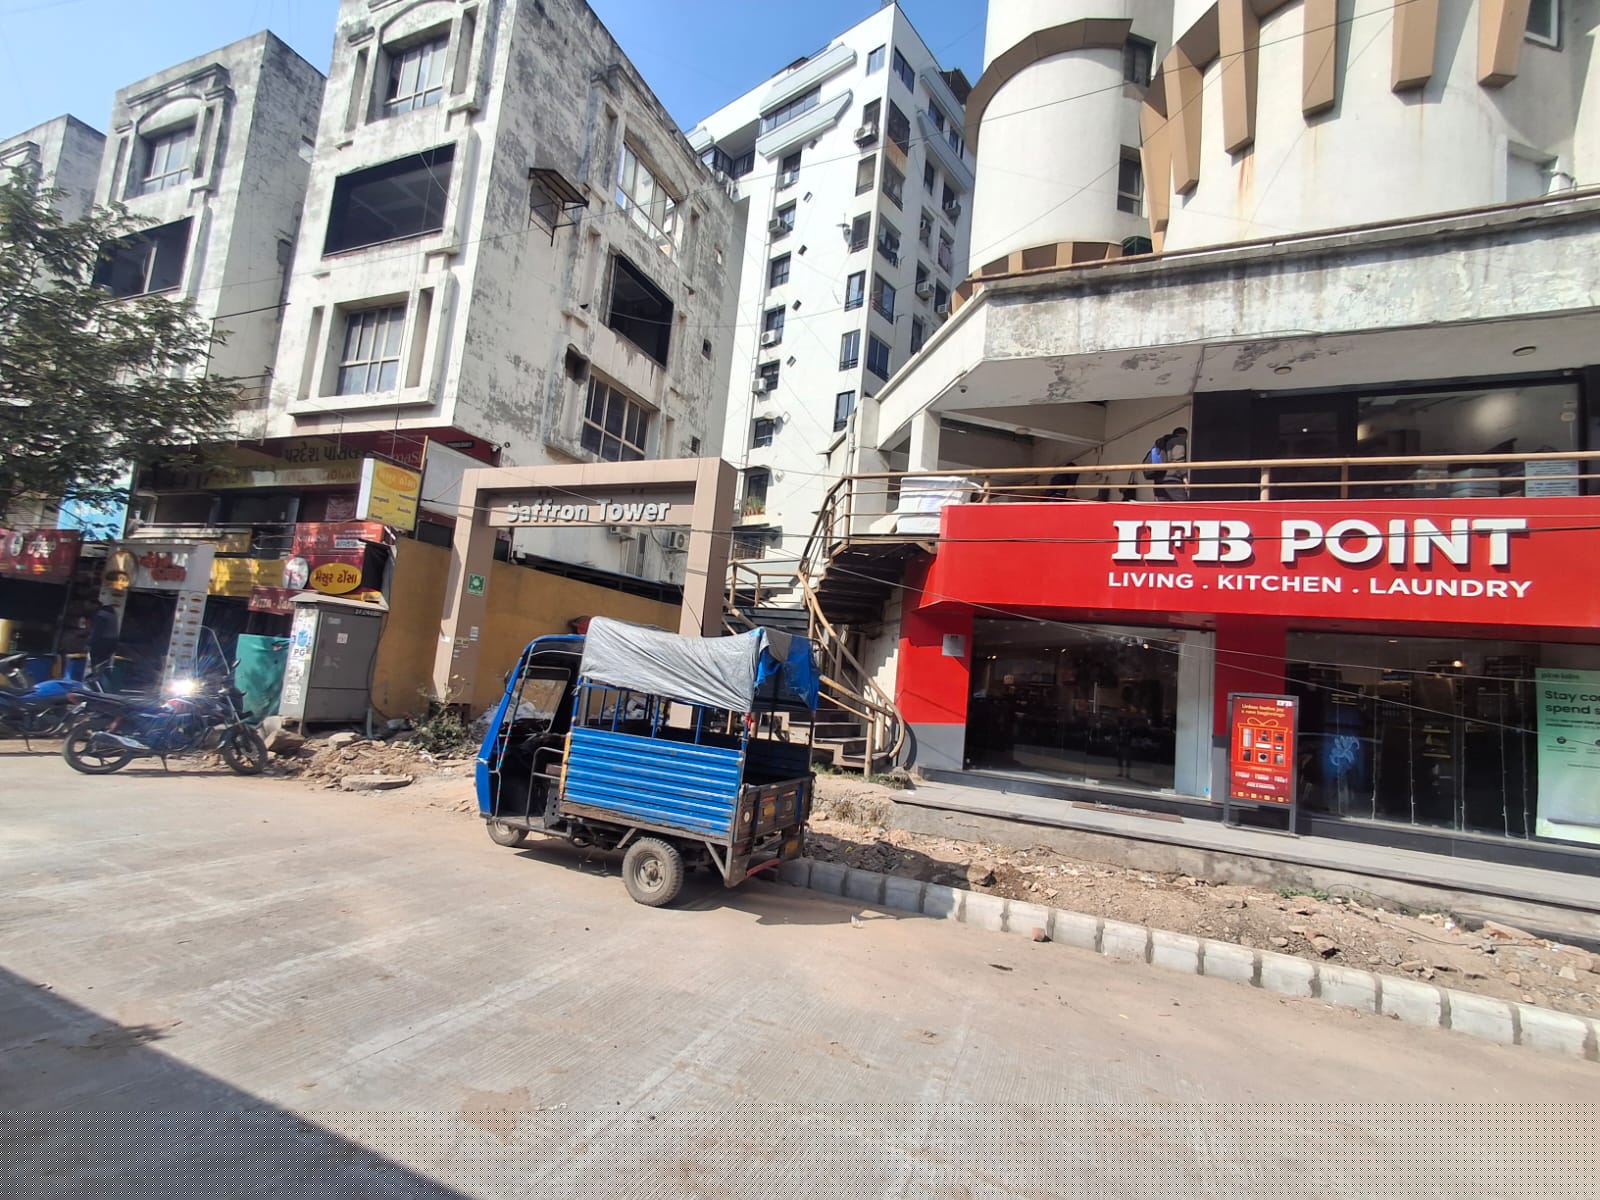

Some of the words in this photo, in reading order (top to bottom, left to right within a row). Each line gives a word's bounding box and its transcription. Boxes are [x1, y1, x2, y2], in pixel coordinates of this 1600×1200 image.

[507, 499, 588, 523] Saffron
[597, 498, 671, 522] Tower
[1111, 519, 1253, 563] IFB
[1280, 518, 1528, 566] POINT
[1108, 572, 1194, 589] LIVING
[1218, 575, 1341, 593] KITCHEN
[1370, 578, 1532, 598] LAUNDRY
[1544, 690, 1578, 704] Stay
[1580, 694, 1600, 702] co
[1544, 704, 1591, 716] spend
